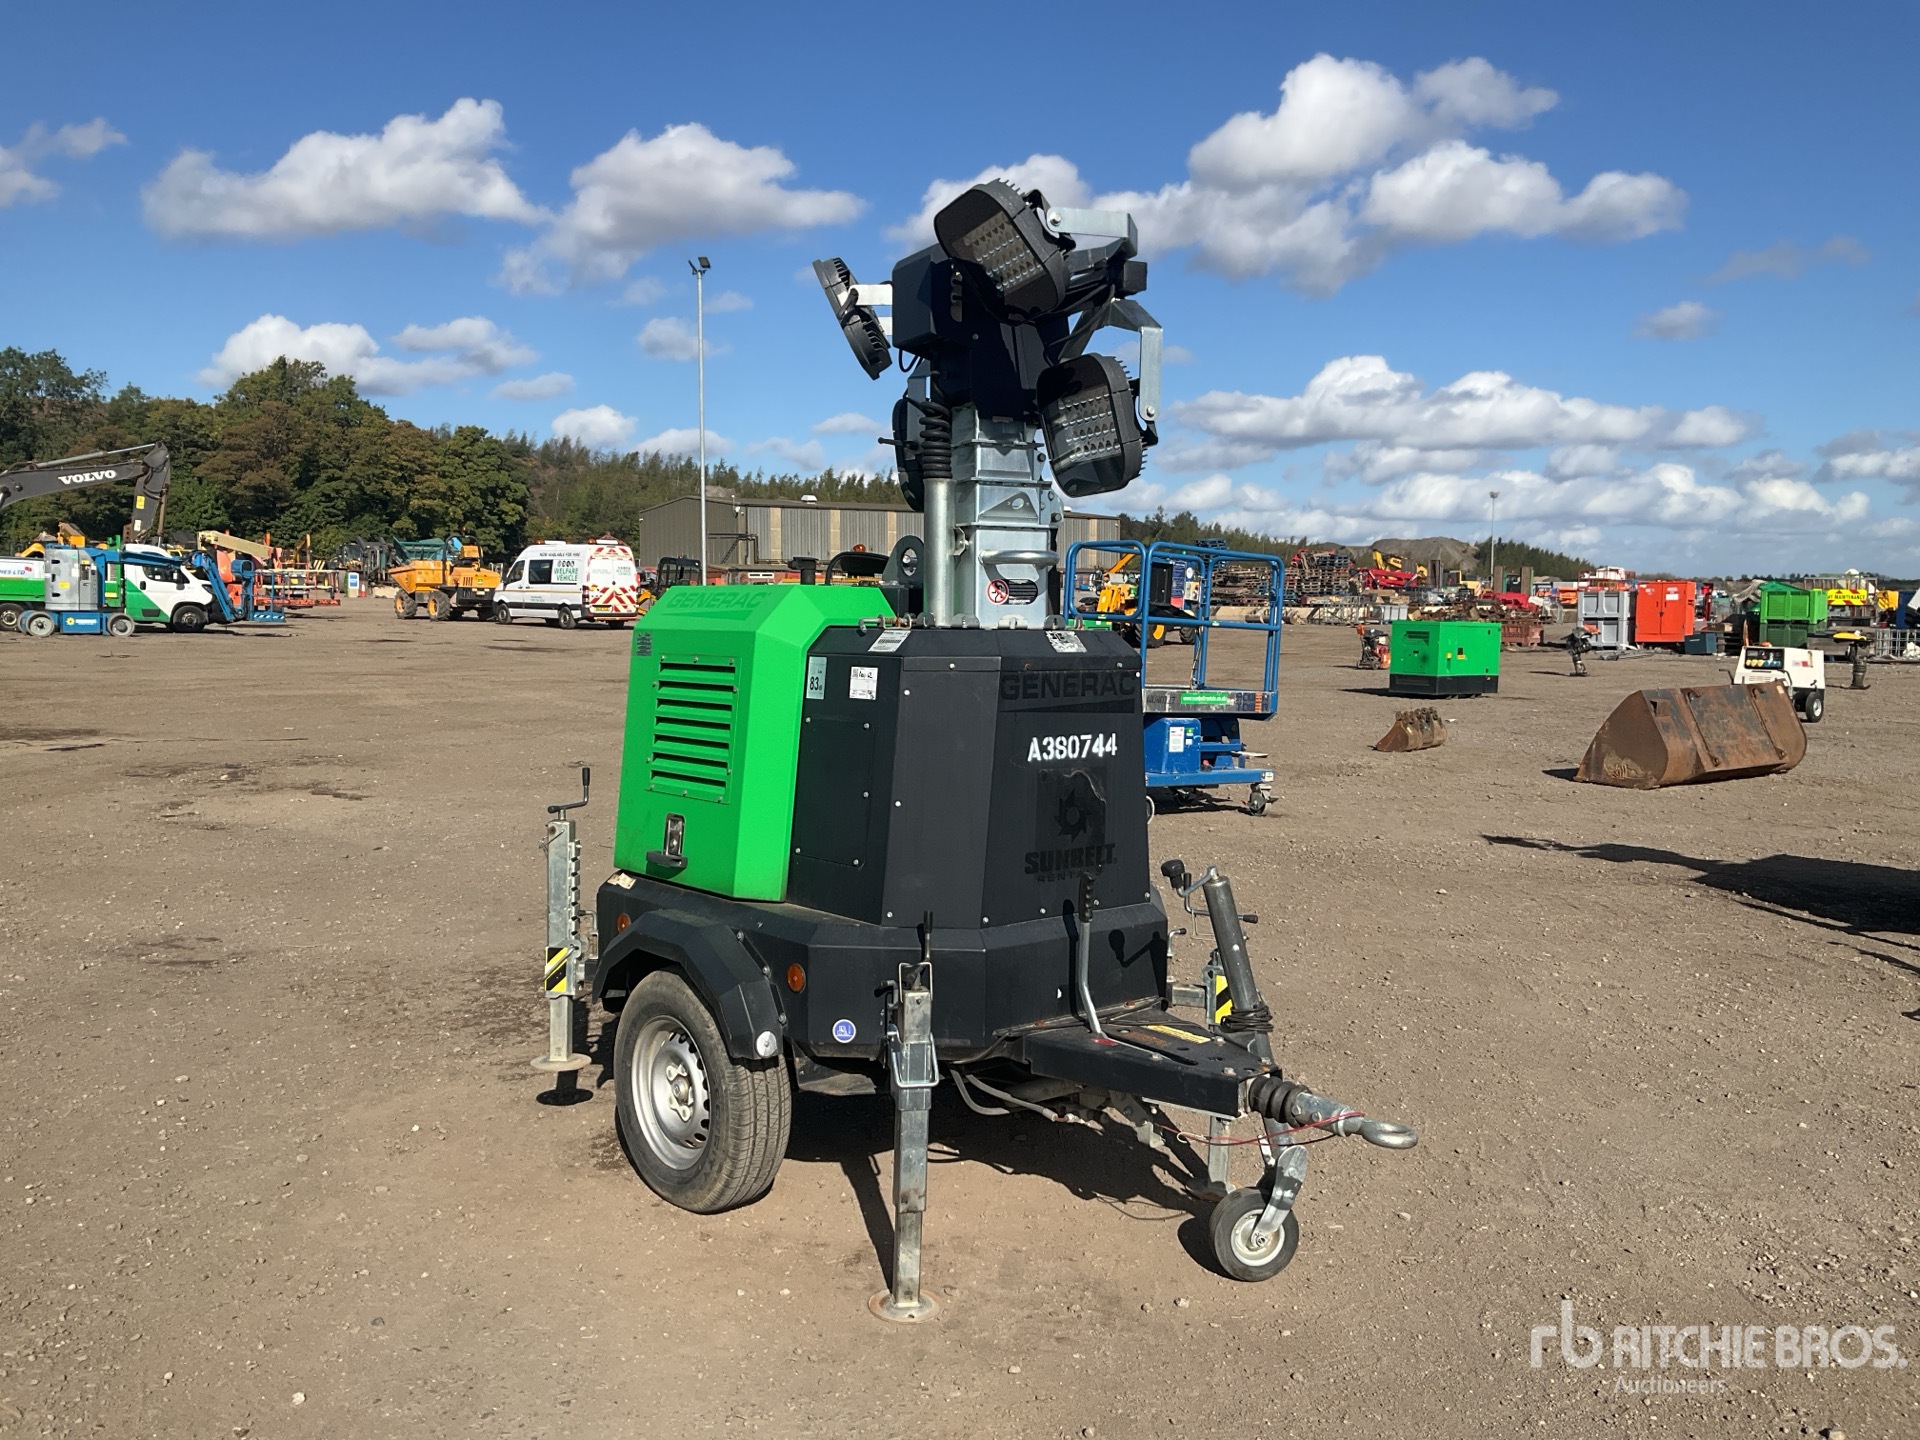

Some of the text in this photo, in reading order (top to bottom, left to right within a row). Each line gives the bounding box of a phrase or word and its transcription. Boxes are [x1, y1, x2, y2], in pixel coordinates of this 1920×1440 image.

[58, 470, 116, 484] VOLVO
[666, 592, 766, 608] GENERAC
[809, 676, 820, 690] 83
[1001, 671, 1136, 700] GENERAC
[1025, 843, 1116, 875] SUNBELT
